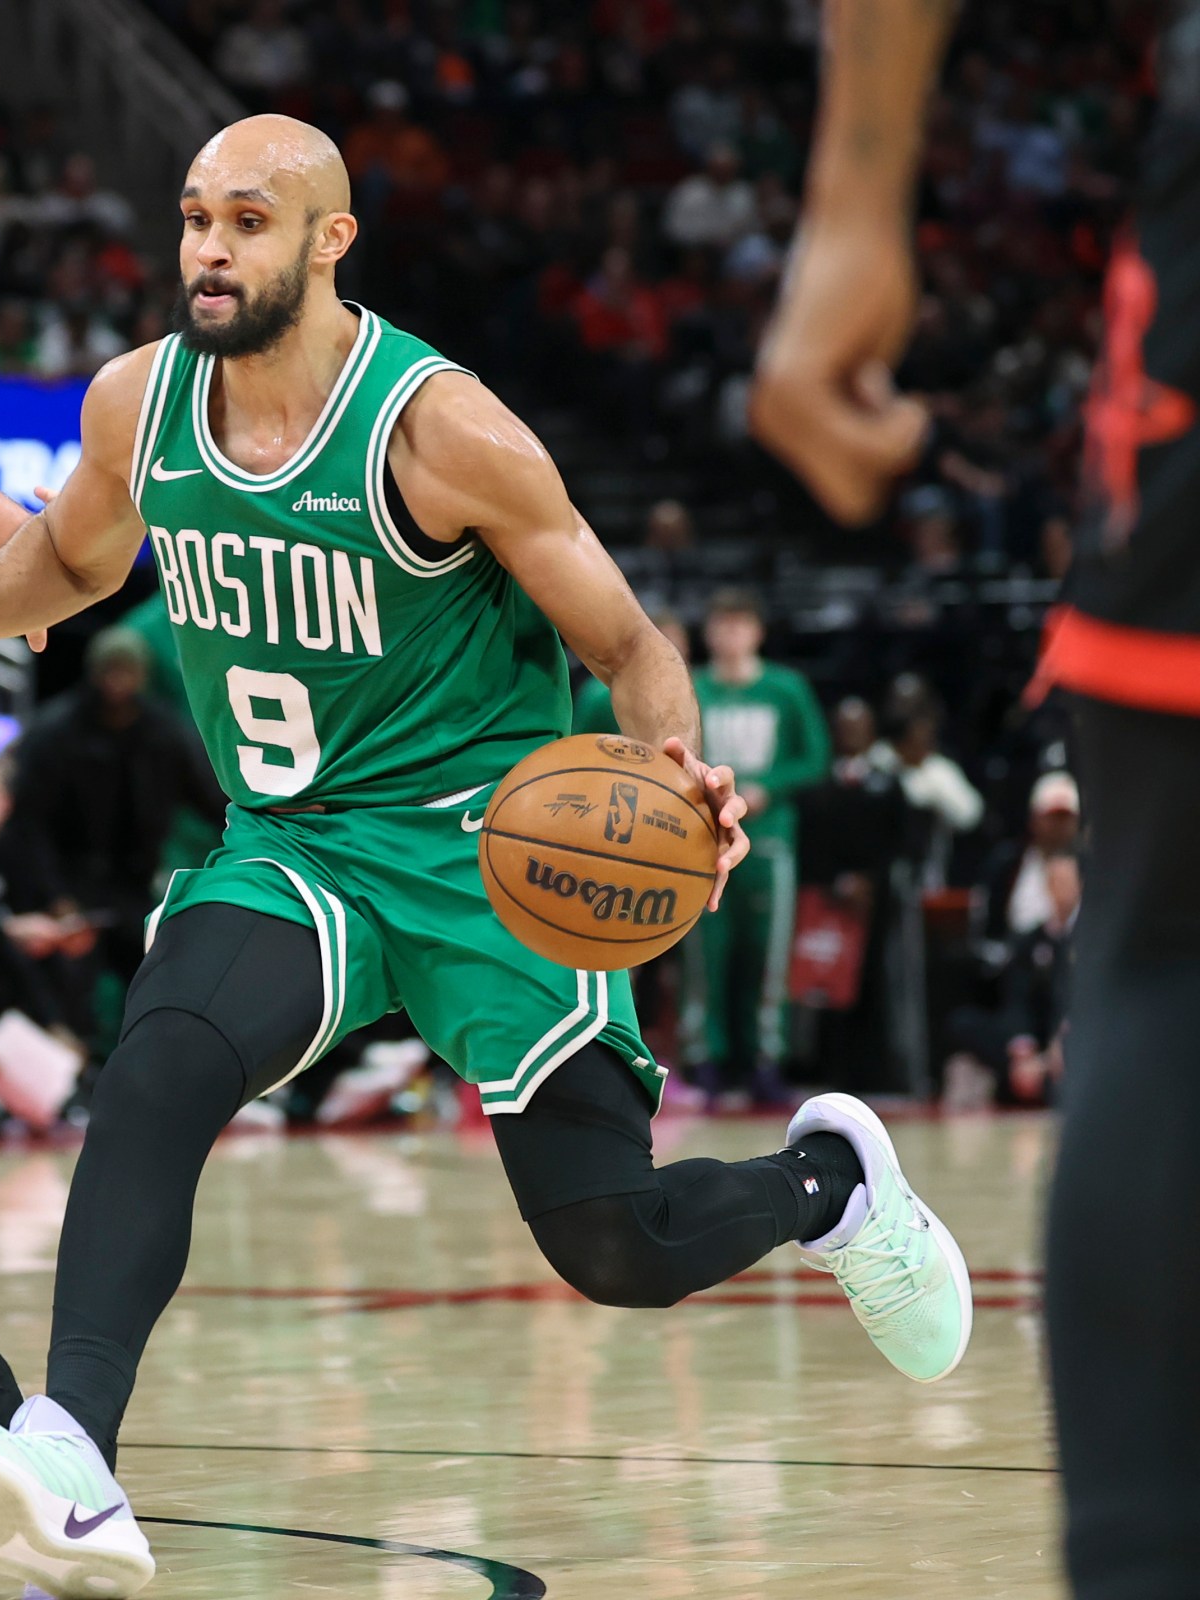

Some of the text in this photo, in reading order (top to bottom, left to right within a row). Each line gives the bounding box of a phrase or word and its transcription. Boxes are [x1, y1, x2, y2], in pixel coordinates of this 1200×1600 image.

[292, 490, 362, 512] Amica
[150, 525, 383, 656] BOSTON
[225, 665, 321, 797] 9
[525, 856, 677, 925] Wilson
